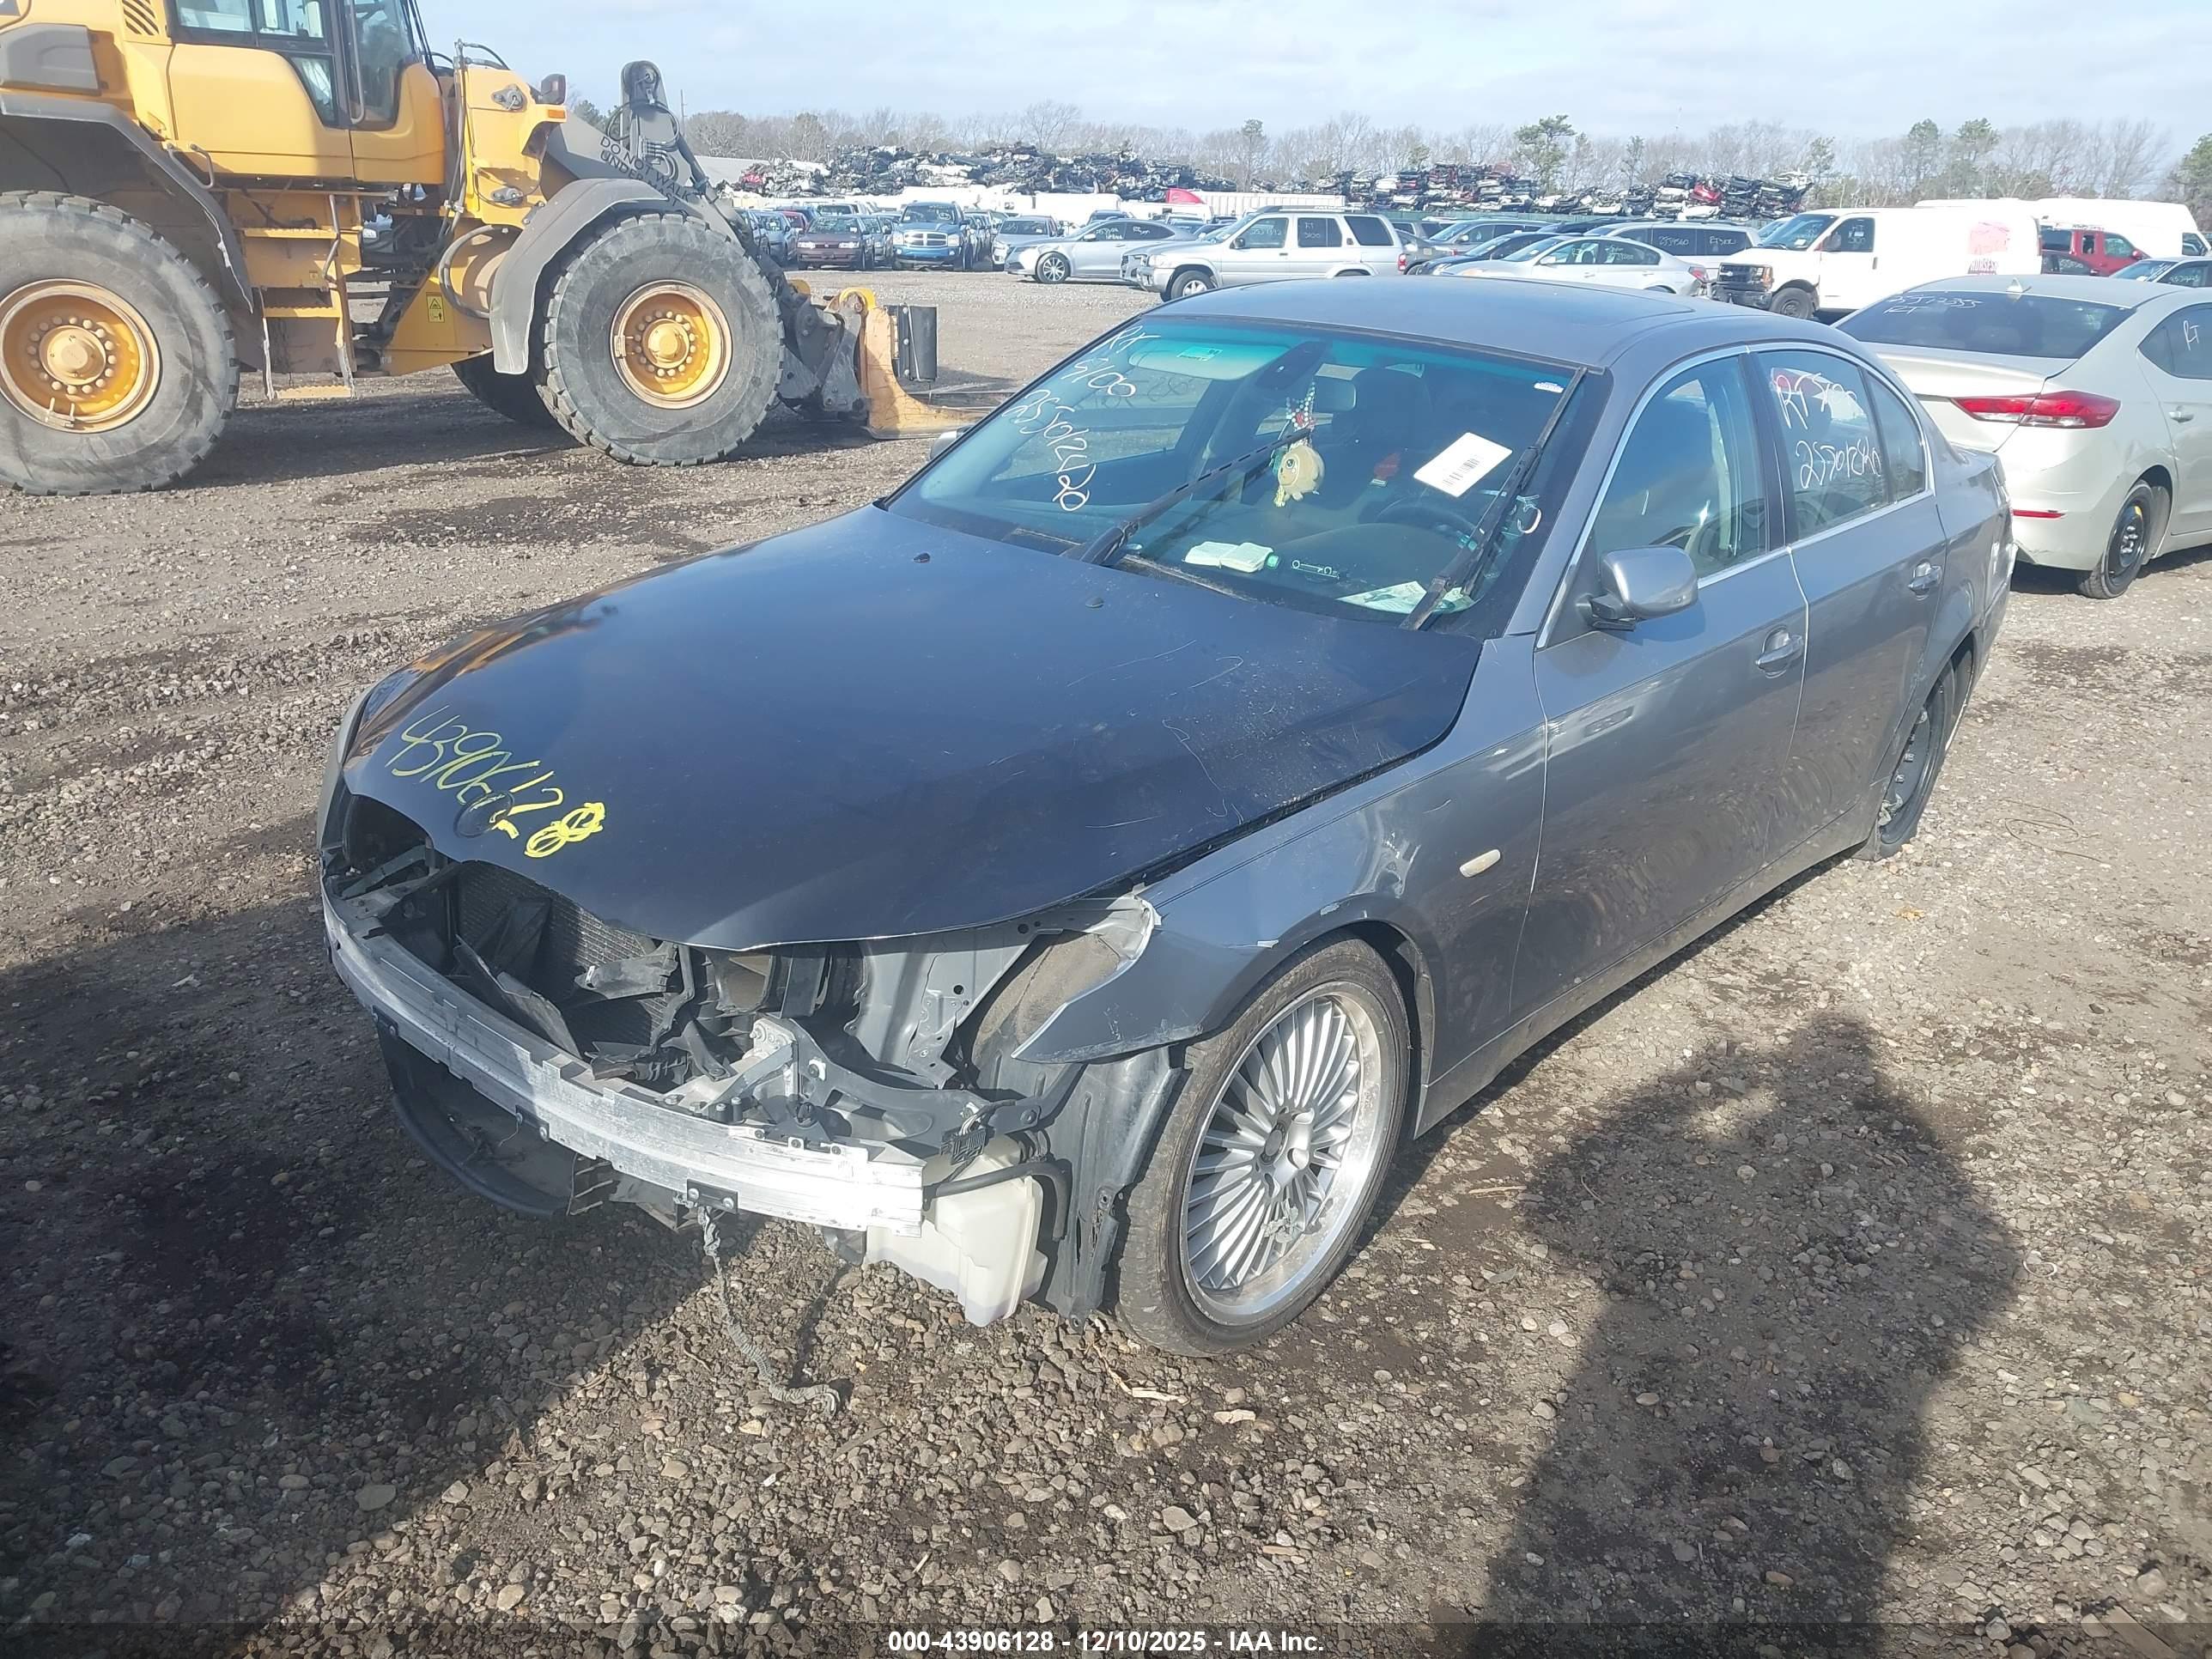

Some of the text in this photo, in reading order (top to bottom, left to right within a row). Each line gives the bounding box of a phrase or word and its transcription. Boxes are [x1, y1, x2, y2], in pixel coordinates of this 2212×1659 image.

[600, 136, 695, 203] DO NOT WALK
